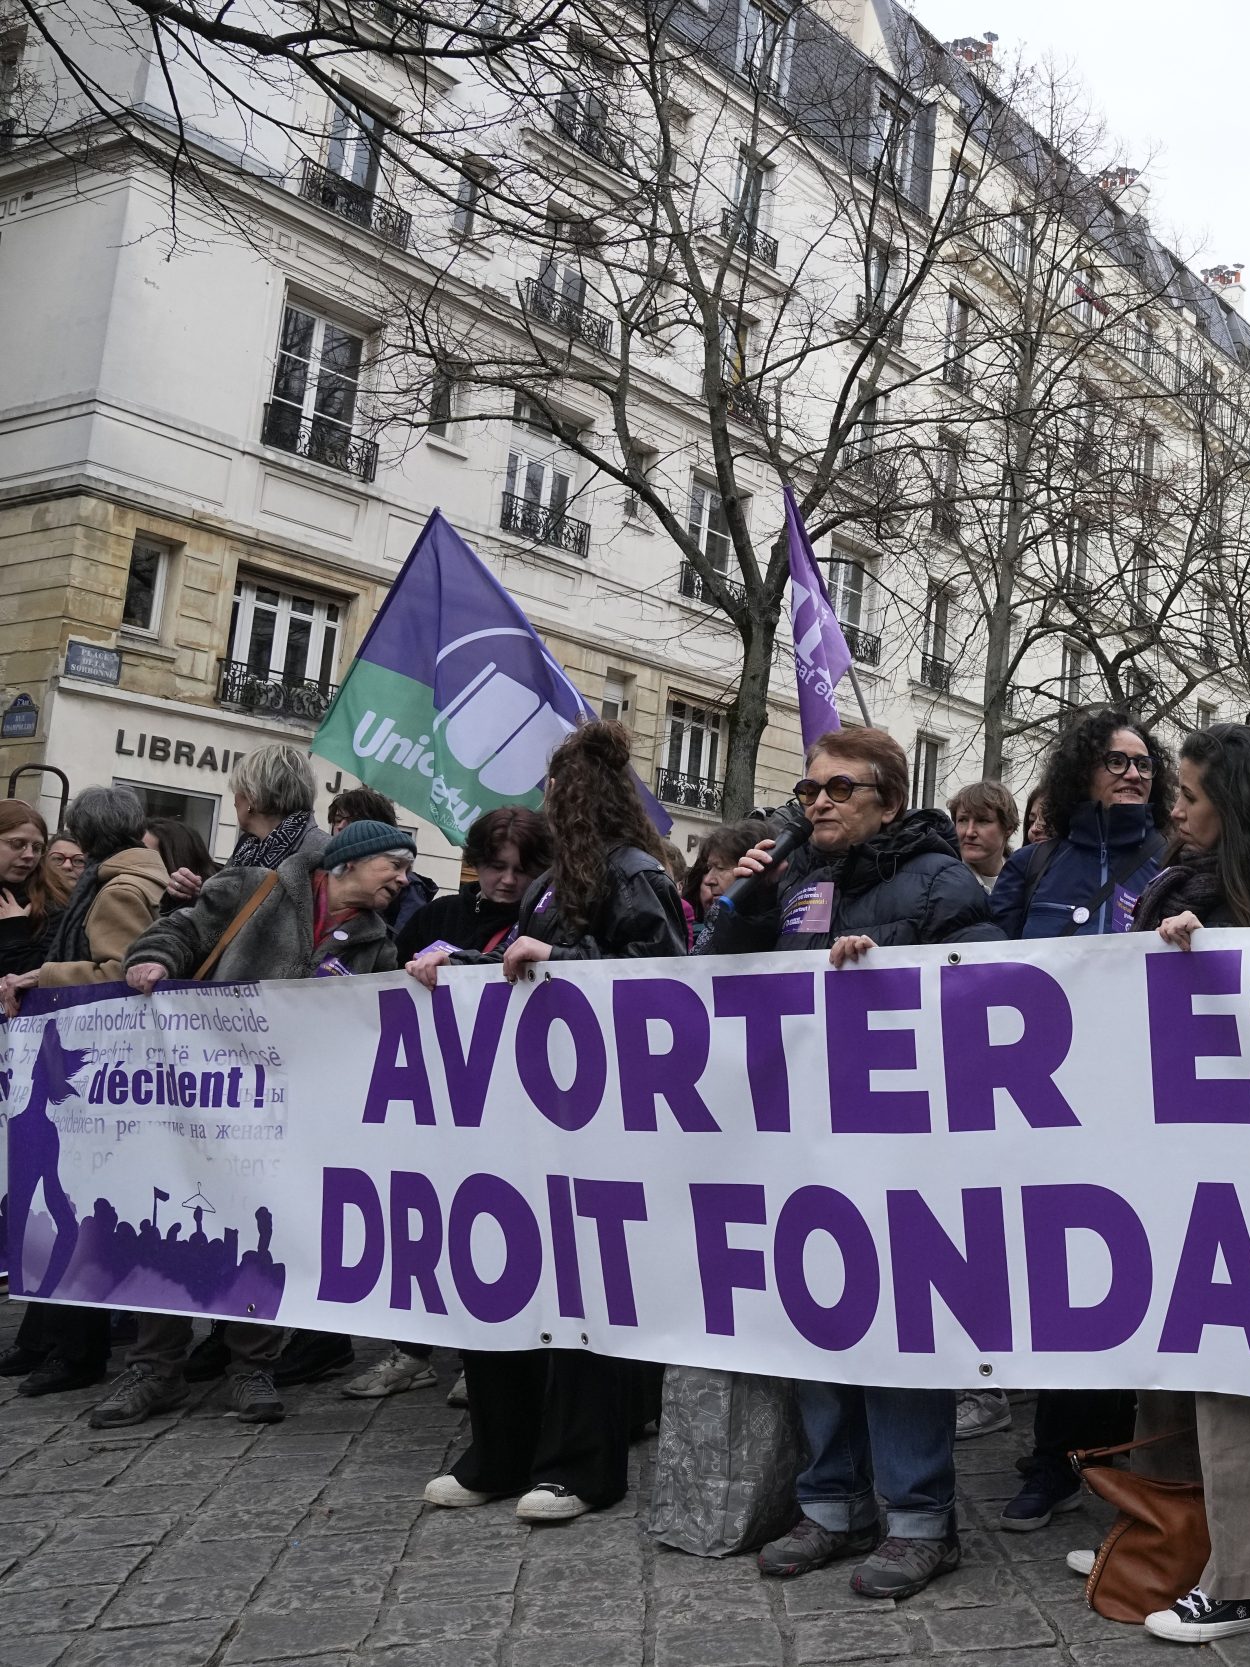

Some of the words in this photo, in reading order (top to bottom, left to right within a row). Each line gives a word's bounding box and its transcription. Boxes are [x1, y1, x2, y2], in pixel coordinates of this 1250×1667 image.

[71, 663, 118, 681] SORBONNE
[81, 648, 110, 661] PLACE
[214, 1008, 270, 1033] decide
[362, 963, 1081, 1133] AVORTER
[88, 1061, 243, 1109] décident
[254, 1063, 266, 1109] !
[317, 1168, 647, 1326] DROIT
